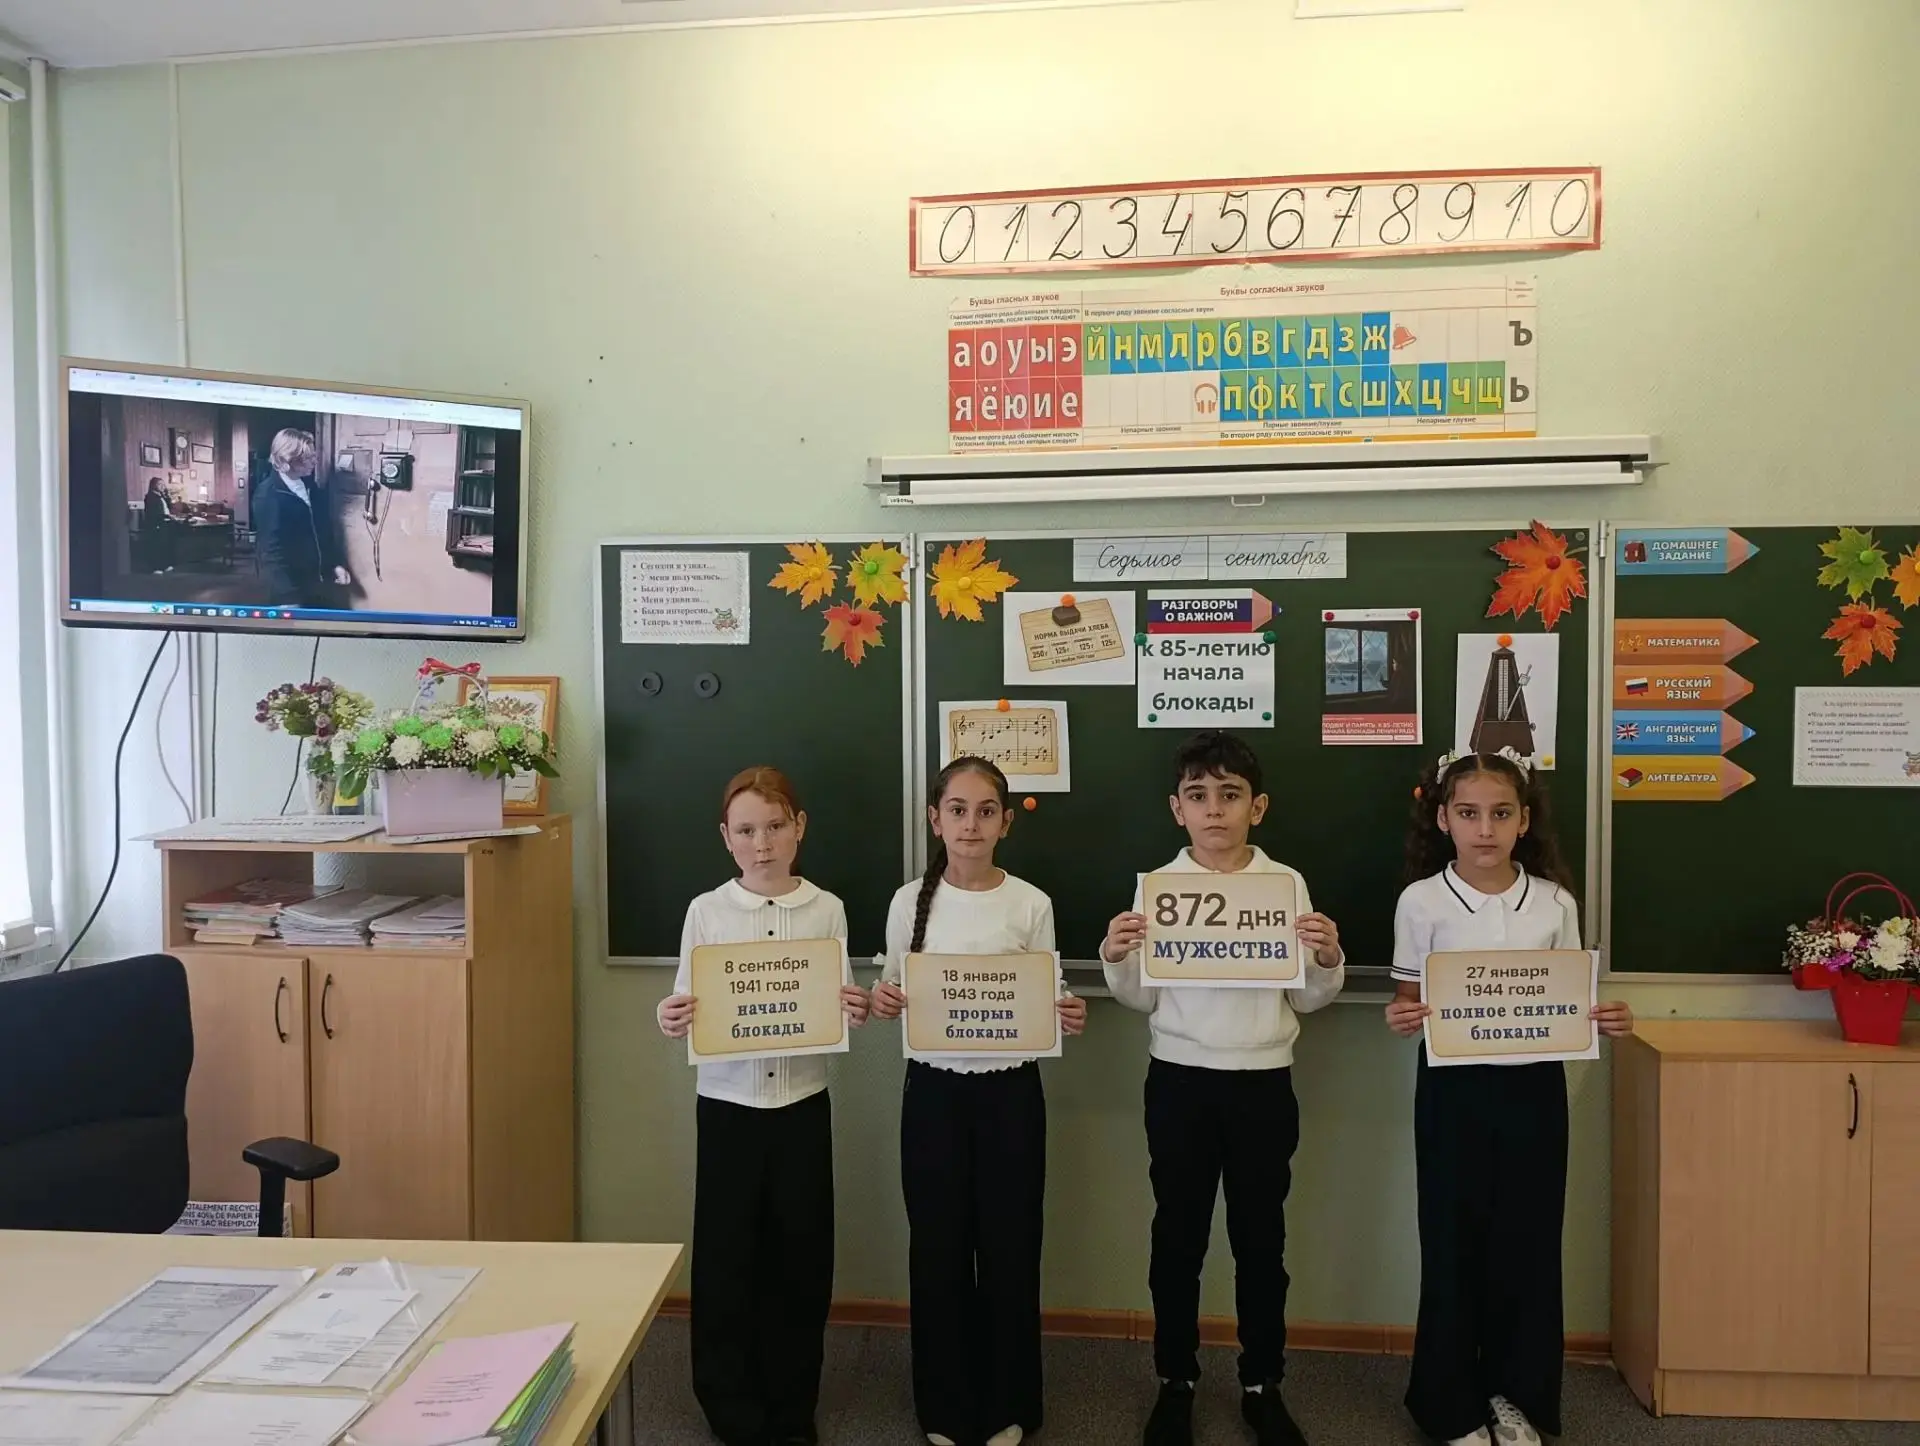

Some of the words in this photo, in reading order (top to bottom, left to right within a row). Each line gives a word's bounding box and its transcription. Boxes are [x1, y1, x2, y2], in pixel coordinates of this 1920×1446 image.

[1220, 287, 1246, 296] Буквы
[1249, 286, 1293, 294] согласных
[1296, 284, 1324, 293] звуков
[969, 298, 994, 307] Буквы
[1032, 294, 1059, 302] звуков
[1652, 541, 1719, 550] ДОМАШНЕЕ
[1098, 545, 1182, 577] Седьмое
[1225, 540, 1330, 575] сентября
[1659, 552, 1712, 561] ЗАДАНИЕ
[1161, 600, 1238, 610] РАЗГОВОРЫ
[1165, 612, 1175, 622] О
[1177, 611, 1234, 622] ВАЖНОМ
[1034, 632, 1057, 640] НОРМА
[1060, 627, 1087, 636] ВЫДАЧИ
[1089, 623, 1109, 632] ХЛЕБА
[1647, 638, 1720, 646] МАТЕМАТИКА
[1142, 643, 1154, 657] к
[1160, 640, 1270, 658] 85-летию
[1164, 667, 1244, 680] начала
[1656, 677, 1712, 688] РУССКИЙ
[1666, 691, 1700, 699] ЯЗЫК
[1153, 692, 1254, 713] блокады
[1645, 724, 1717, 733] АНГЛИЙСКИЙ
[1666, 735, 1695, 743] ЯЗЫК
[1647, 774, 1716, 782] ЛИТЕРАТУРА
[1156, 893, 1227, 927] 872
[1237, 910, 1286, 930] дня
[1153, 941, 1288, 964] мужества
[725, 961, 734, 973] 8
[739, 957, 809, 973] сентября
[942, 970, 958, 982] 18
[964, 972, 1016, 984] января
[1466, 967, 1485, 978] 27
[1490, 967, 1549, 979] января
[730, 980, 761, 994] 1941
[766, 980, 800, 992] года
[1465, 984, 1503, 996] 1944
[1508, 985, 1545, 996] года
[941, 989, 976, 999] 1943
[982, 990, 1015, 1001] года
[738, 1001, 797, 1016] начало
[949, 1009, 1014, 1021] прорыв
[1440, 1006, 1506, 1019] полное
[1513, 1004, 1578, 1017] снятие
[732, 1022, 805, 1038] блокады
[946, 1025, 1018, 1040] блокады
[1471, 1025, 1549, 1040] блокады
